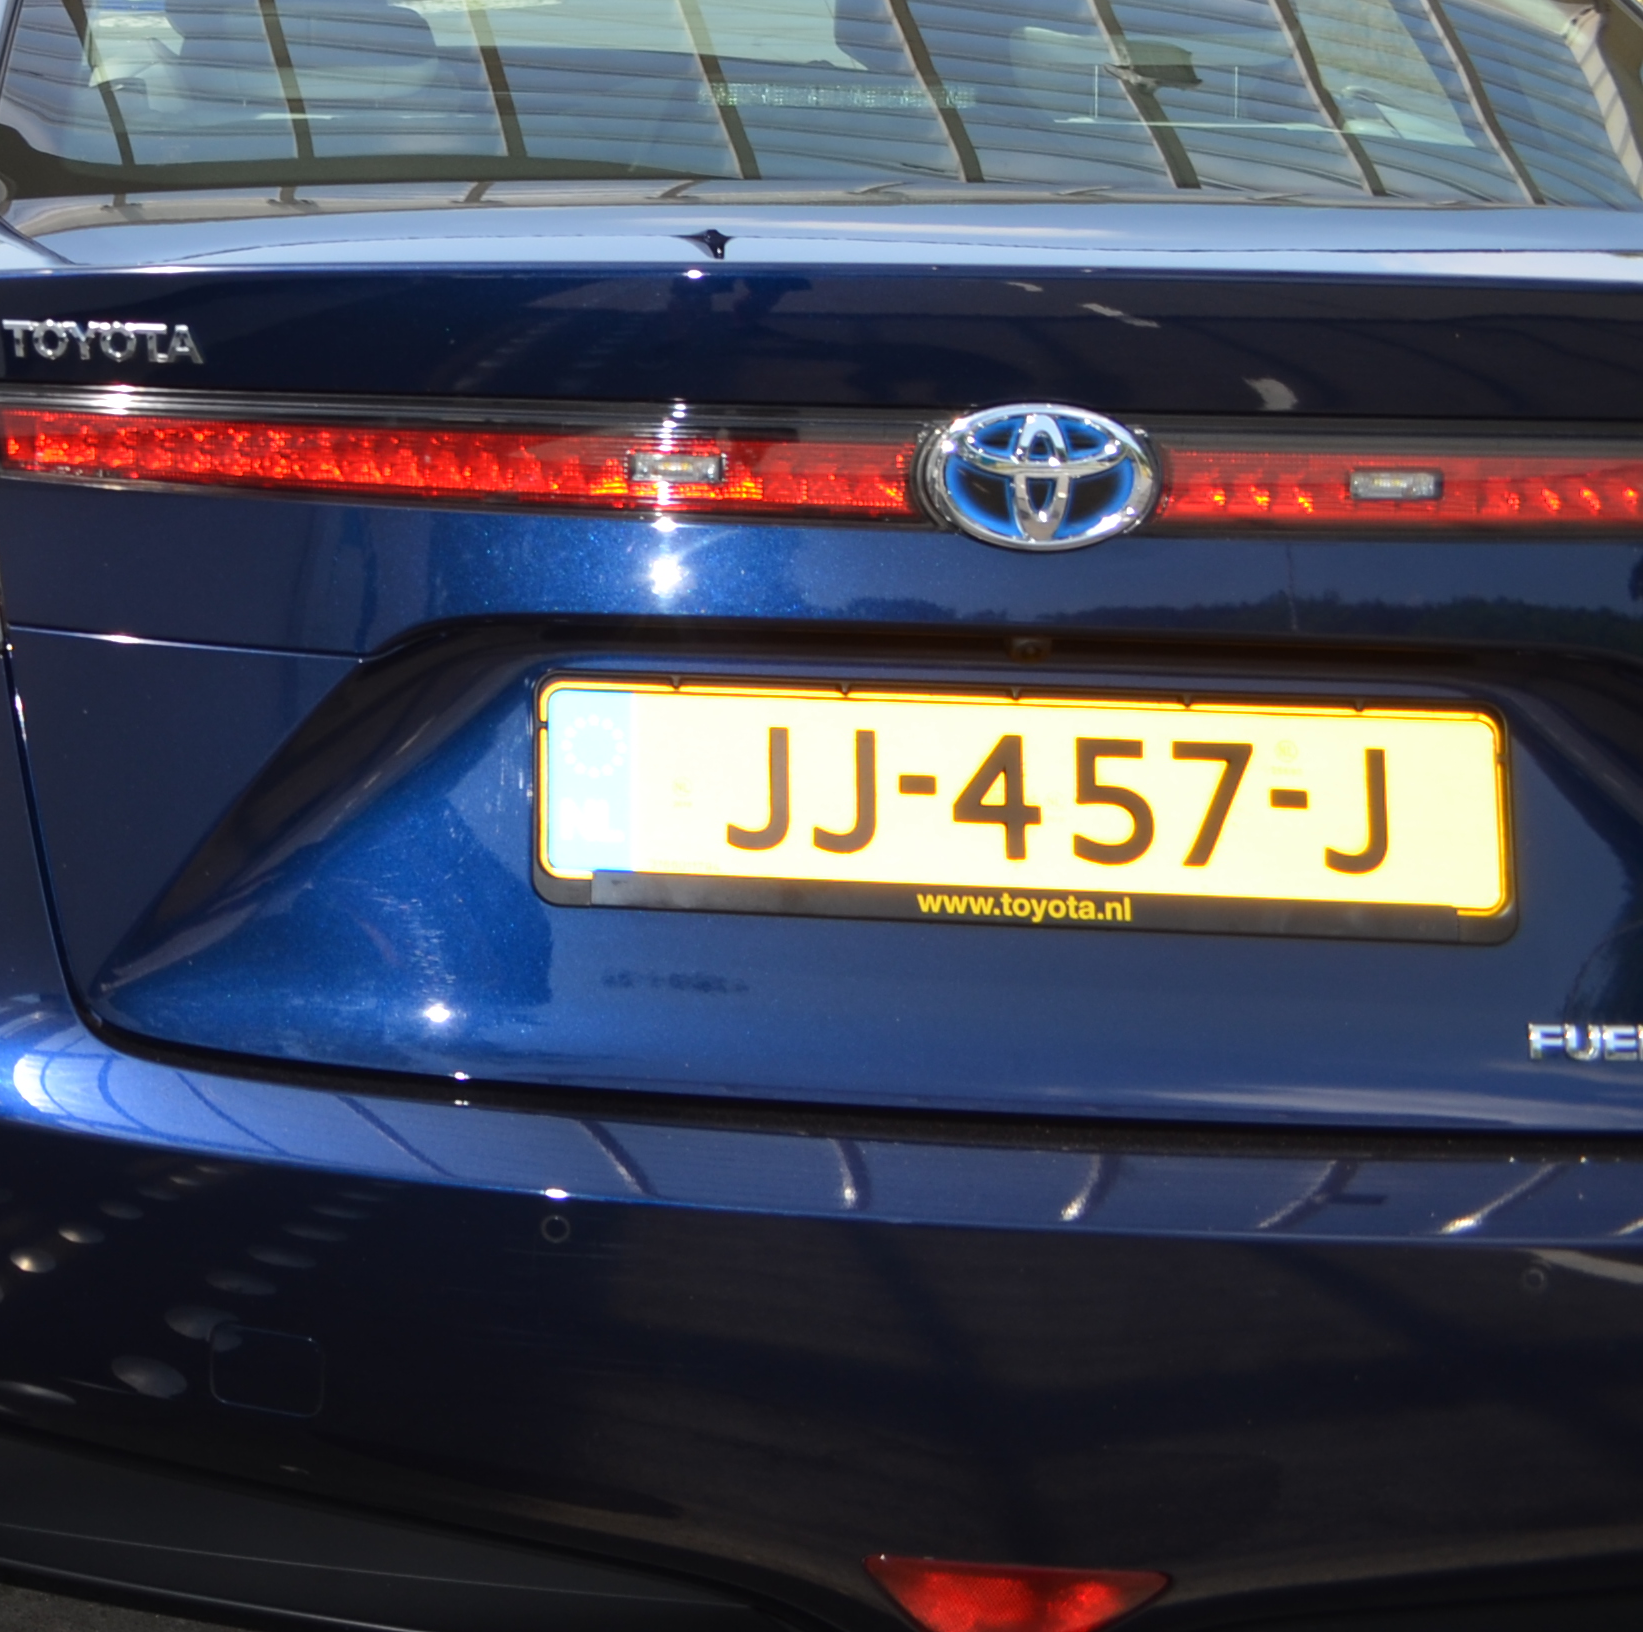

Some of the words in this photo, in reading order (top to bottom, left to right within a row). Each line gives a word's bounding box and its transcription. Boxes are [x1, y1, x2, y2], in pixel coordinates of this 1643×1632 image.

[2, 319, 204, 364] TOYOTA
[560, 797, 625, 843] NL
[727, 727, 1389, 875] JJ-457-J
[917, 892, 1132, 923] www.toyota.nl
